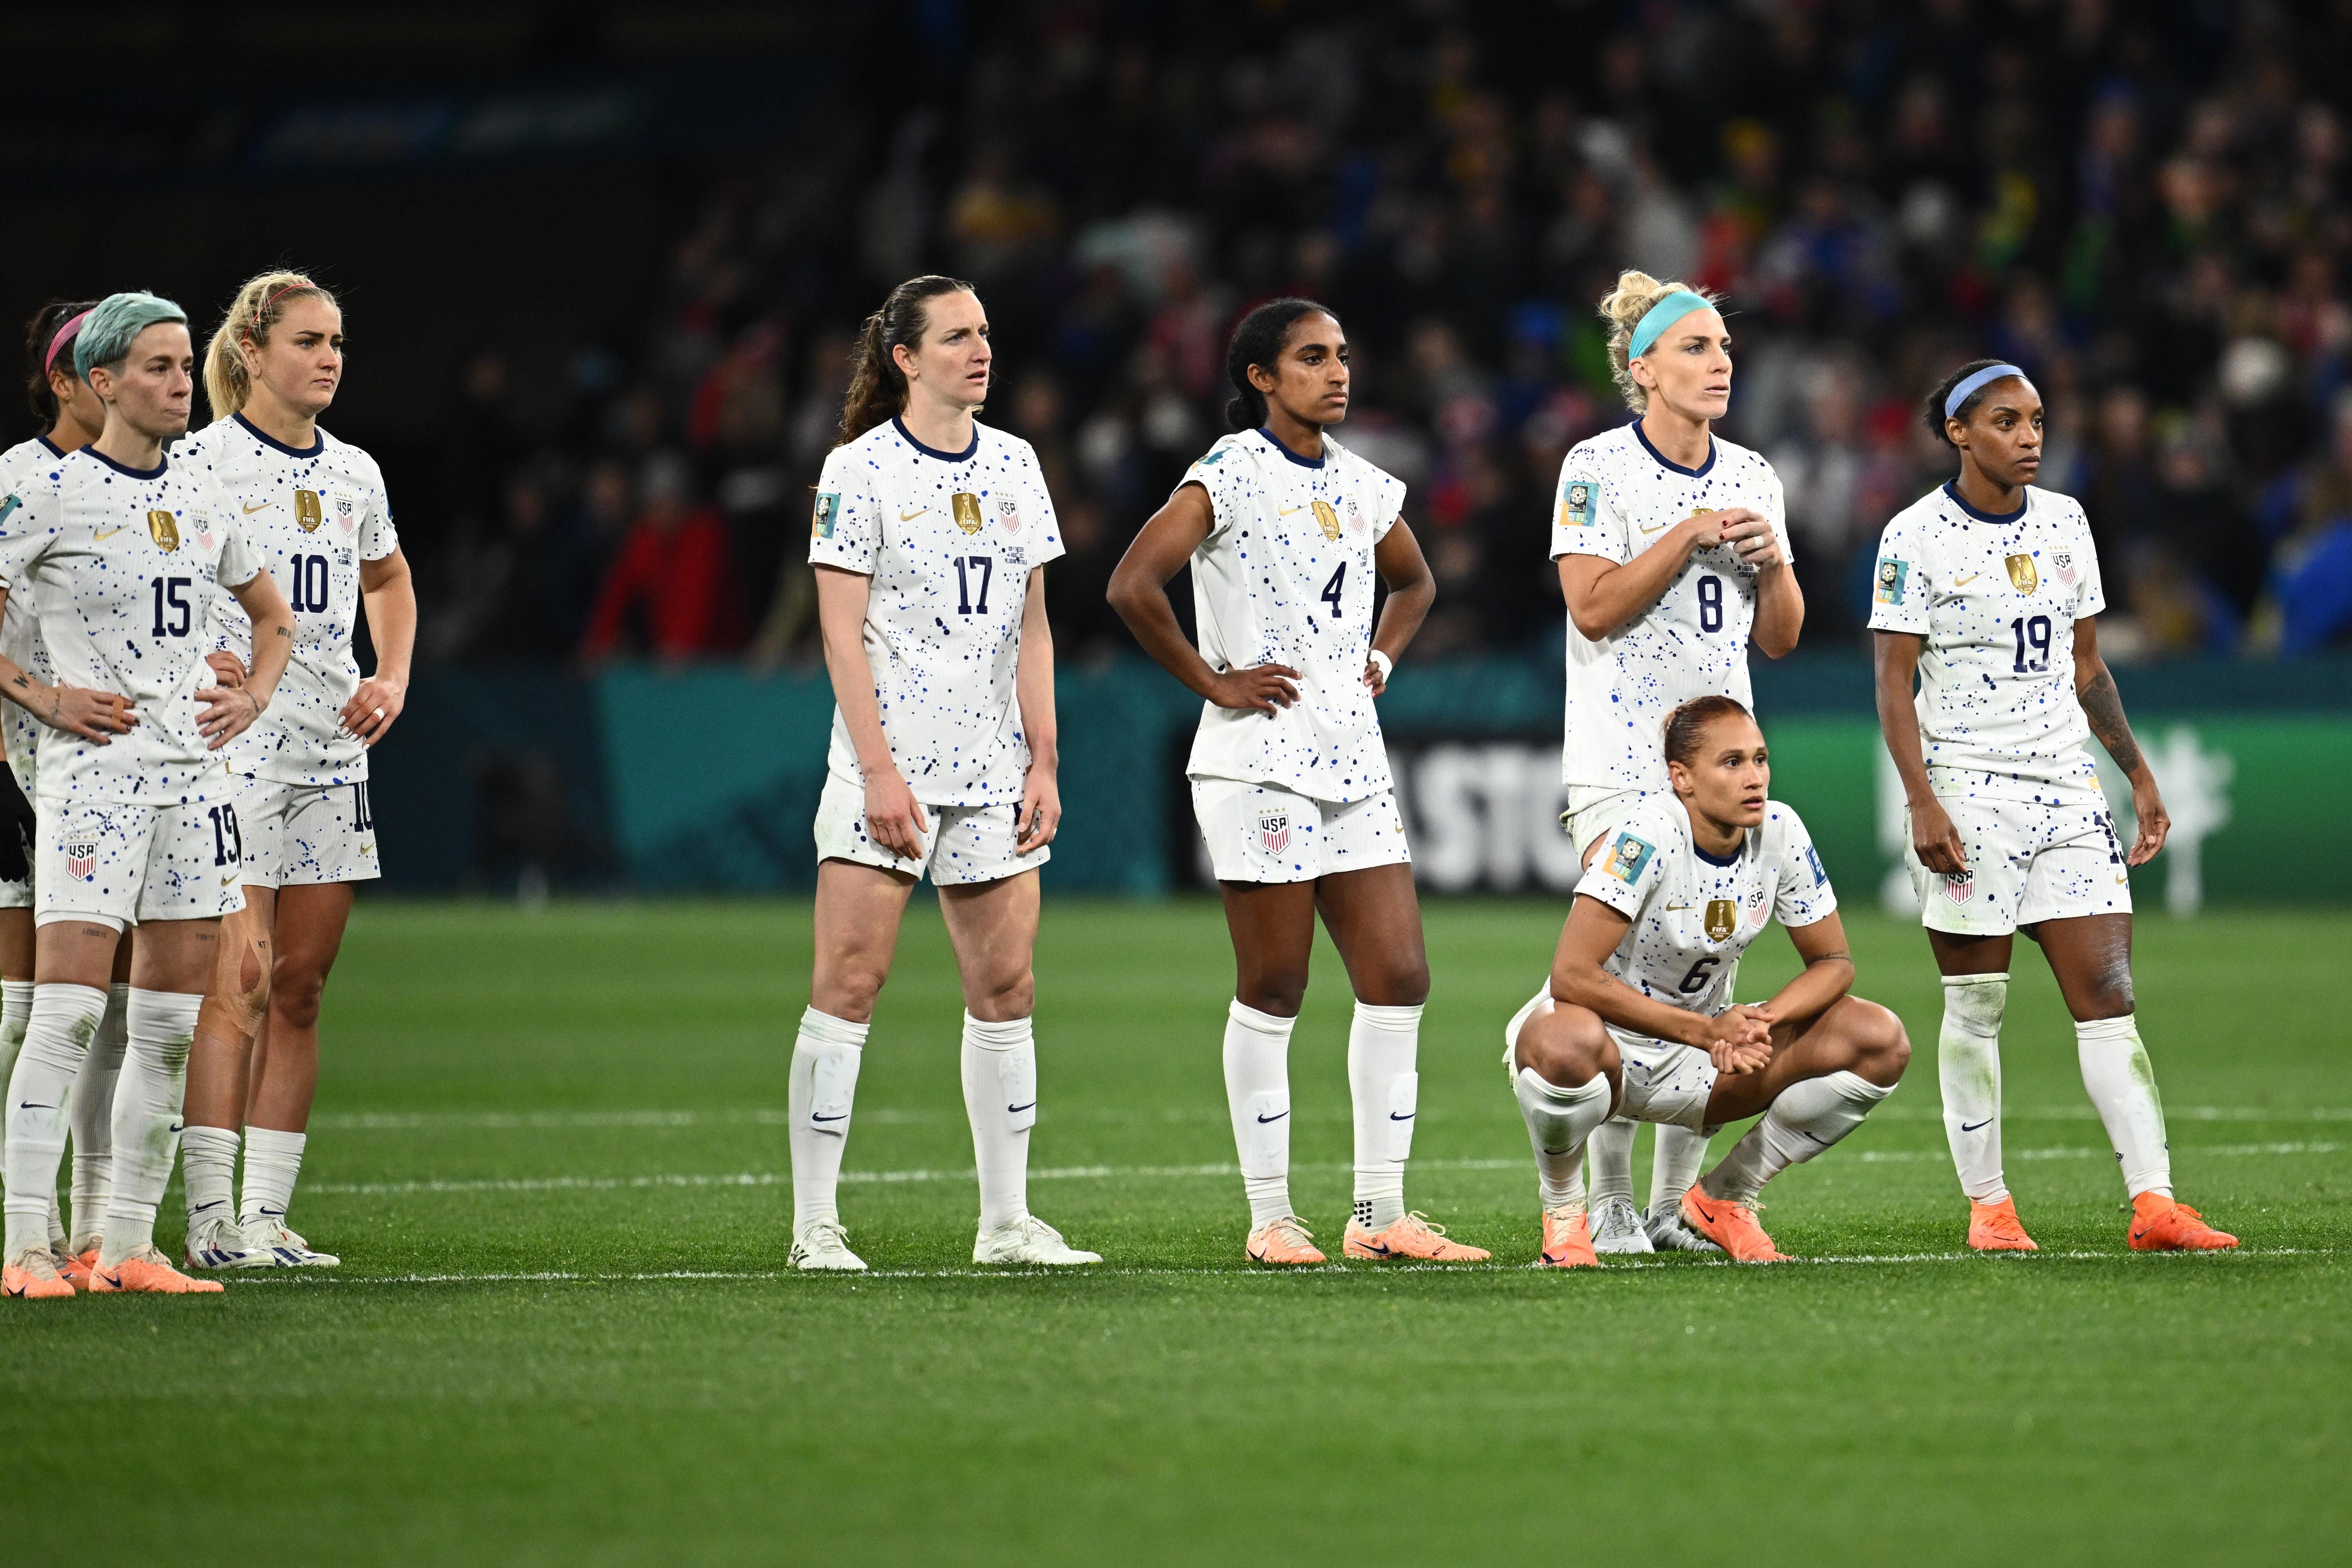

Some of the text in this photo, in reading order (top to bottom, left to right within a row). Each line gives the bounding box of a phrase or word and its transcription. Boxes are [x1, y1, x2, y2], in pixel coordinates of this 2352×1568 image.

[337, 501, 352, 515] USA
[999, 501, 1015, 515] USA
[193, 519, 208, 533] USA
[2053, 555, 2071, 568] USA
[291, 554, 328, 613] 10
[954, 556, 992, 615] 17
[1321, 562, 1346, 618] 4
[151, 577, 191, 637] 15
[1697, 576, 1723, 633] 8
[2010, 615, 2052, 673] 19
[1262, 817, 1286, 832] USA
[69, 845, 94, 859] USA
[258, 941, 266, 949] KT
[1679, 957, 1721, 994] 6
